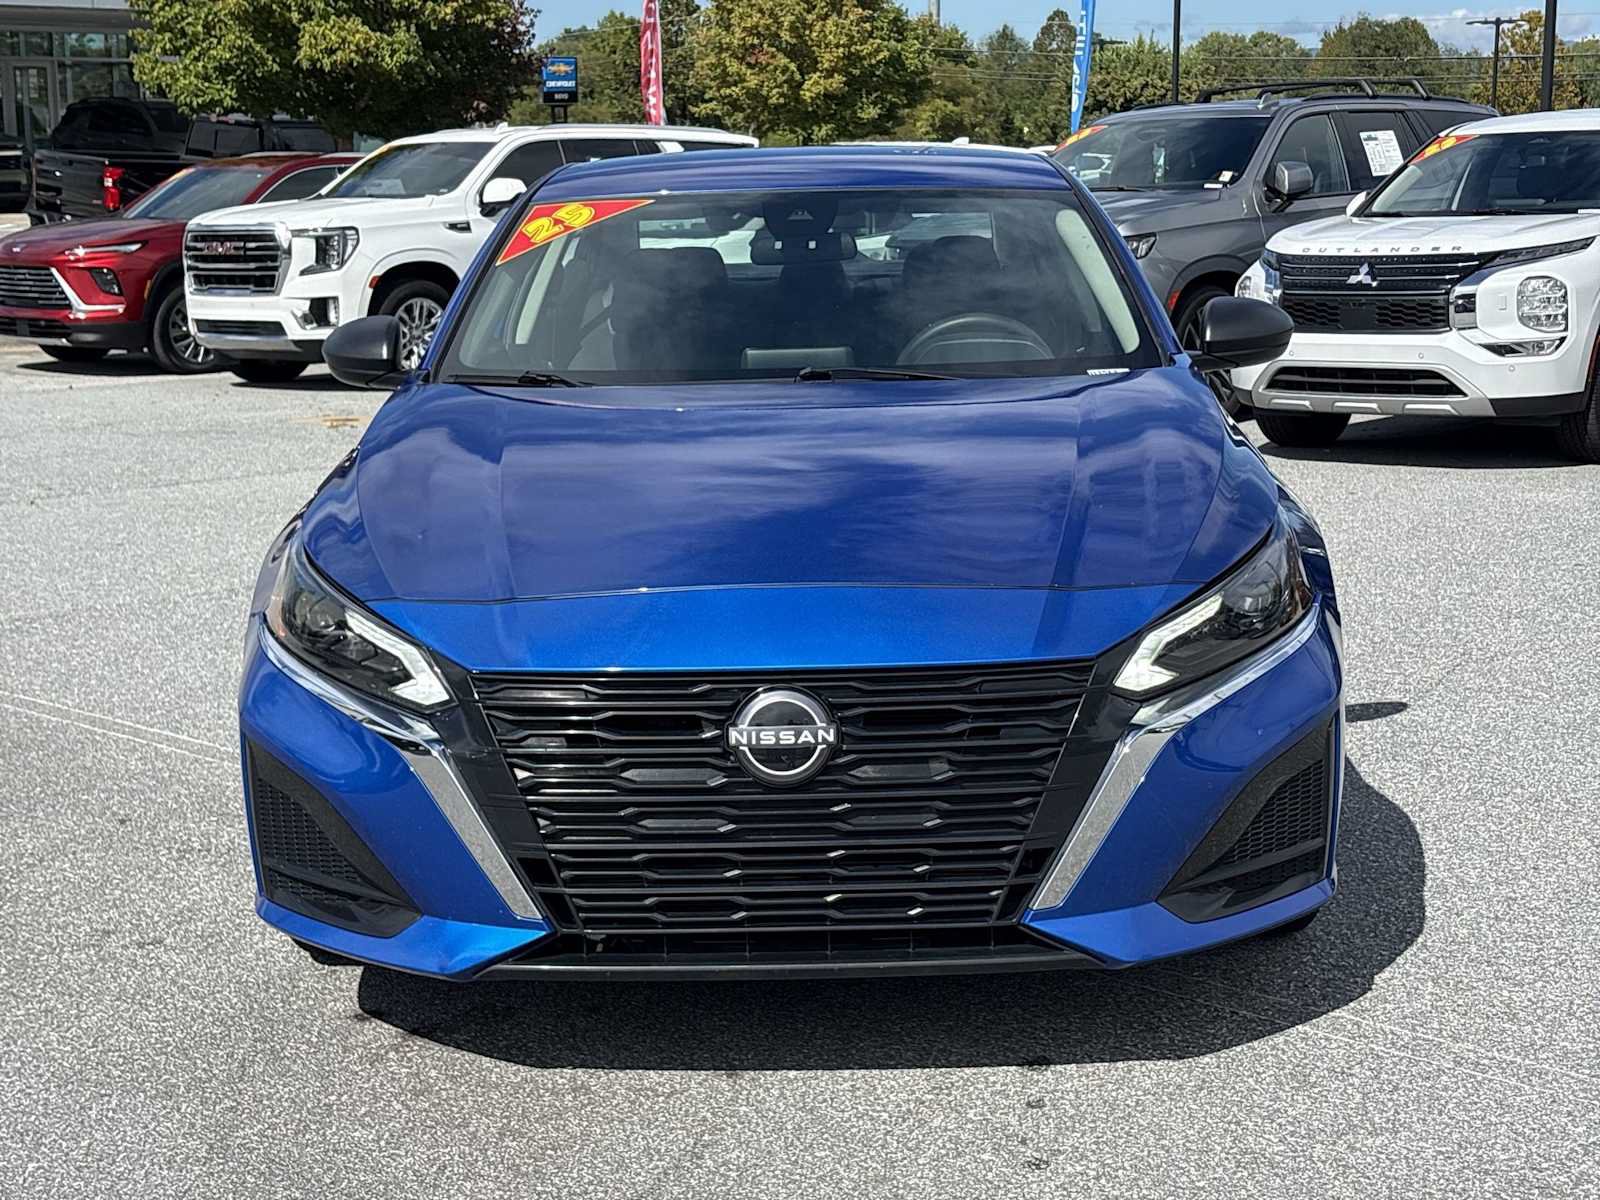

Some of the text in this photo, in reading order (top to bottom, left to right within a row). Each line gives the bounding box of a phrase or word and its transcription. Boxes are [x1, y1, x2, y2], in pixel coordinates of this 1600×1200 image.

[521, 203, 595, 244] 25
[1302, 246, 1463, 254] OUTLANDER
[731, 728, 834, 745] NISSAN
